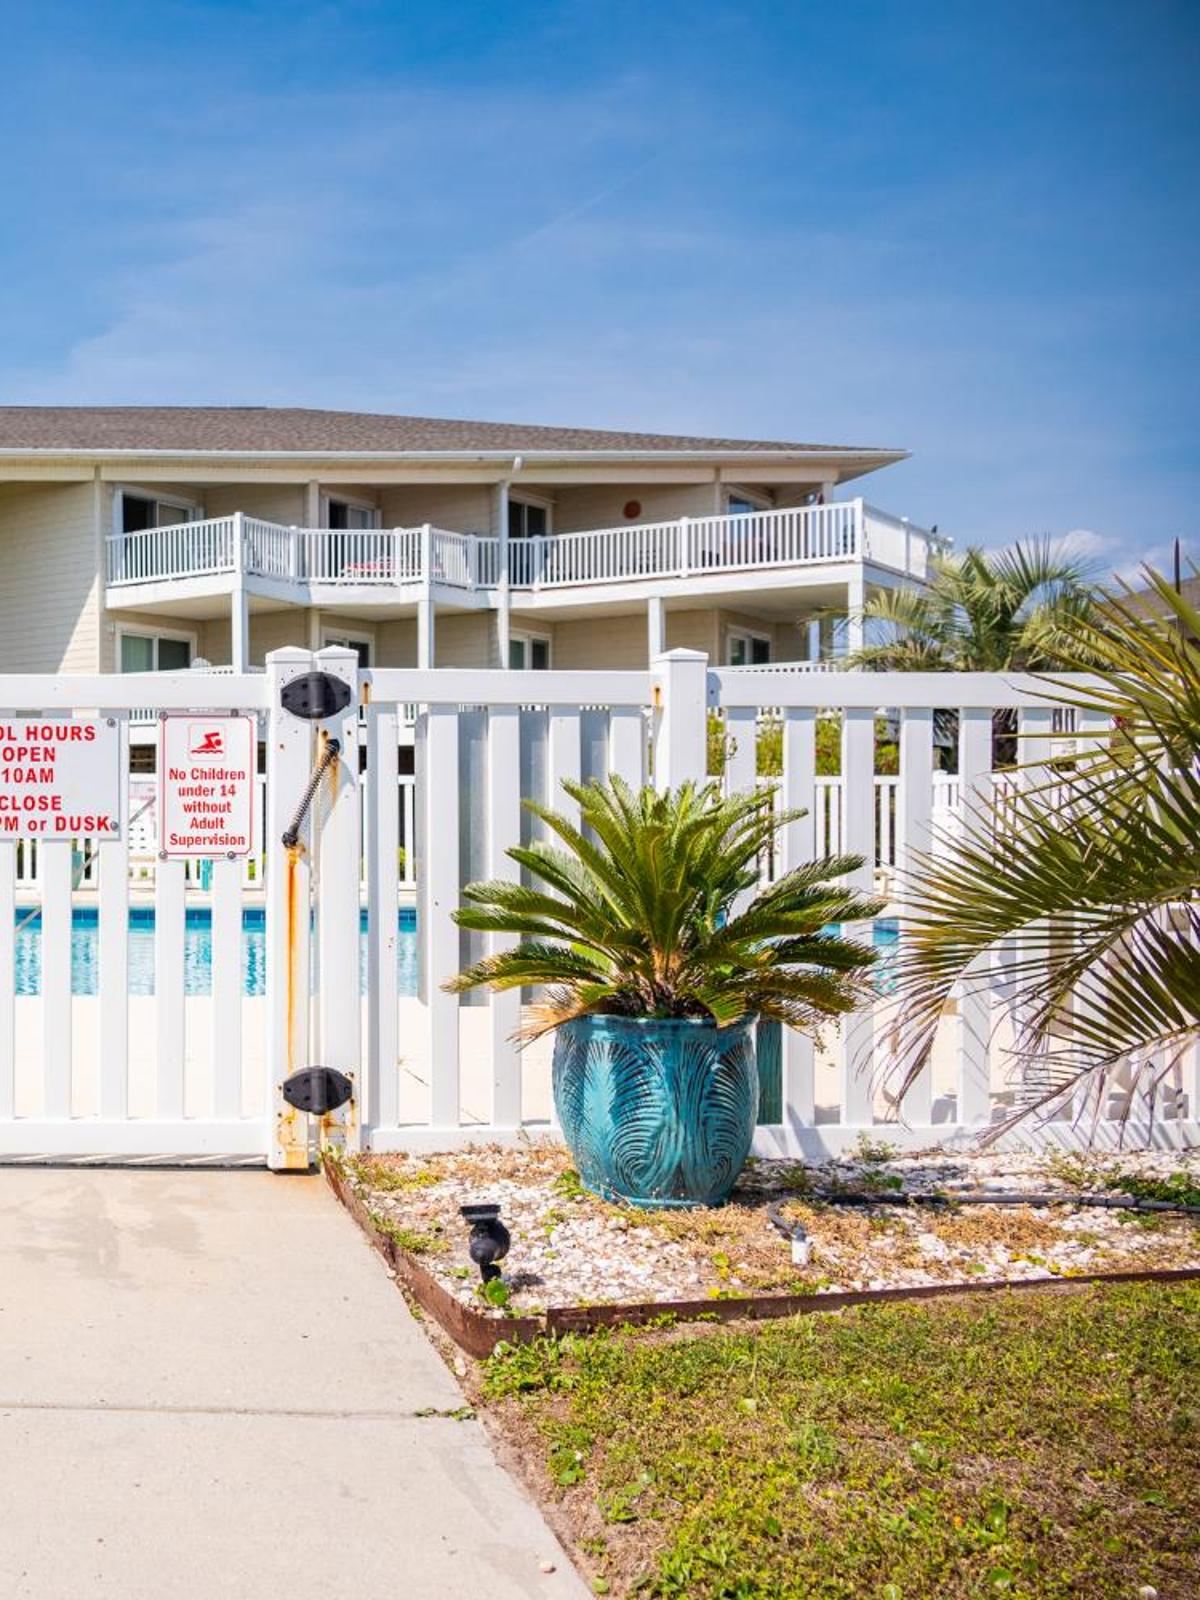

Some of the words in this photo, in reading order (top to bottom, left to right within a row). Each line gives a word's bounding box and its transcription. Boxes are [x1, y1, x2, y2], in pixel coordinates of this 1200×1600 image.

[26, 726, 96, 741] HOURS
[2, 747, 56, 762] OPEN
[1, 768, 54, 783] 10AM
[169, 768, 186, 780] No
[191, 768, 246, 780] Children
[178, 785, 215, 797] under
[220, 785, 236, 797] 14
[183, 802, 232, 814] without
[28, 820, 47, 832] or
[56, 816, 108, 832] DUSK
[190, 818, 225, 830] Adult
[170, 834, 246, 848] Supervision
